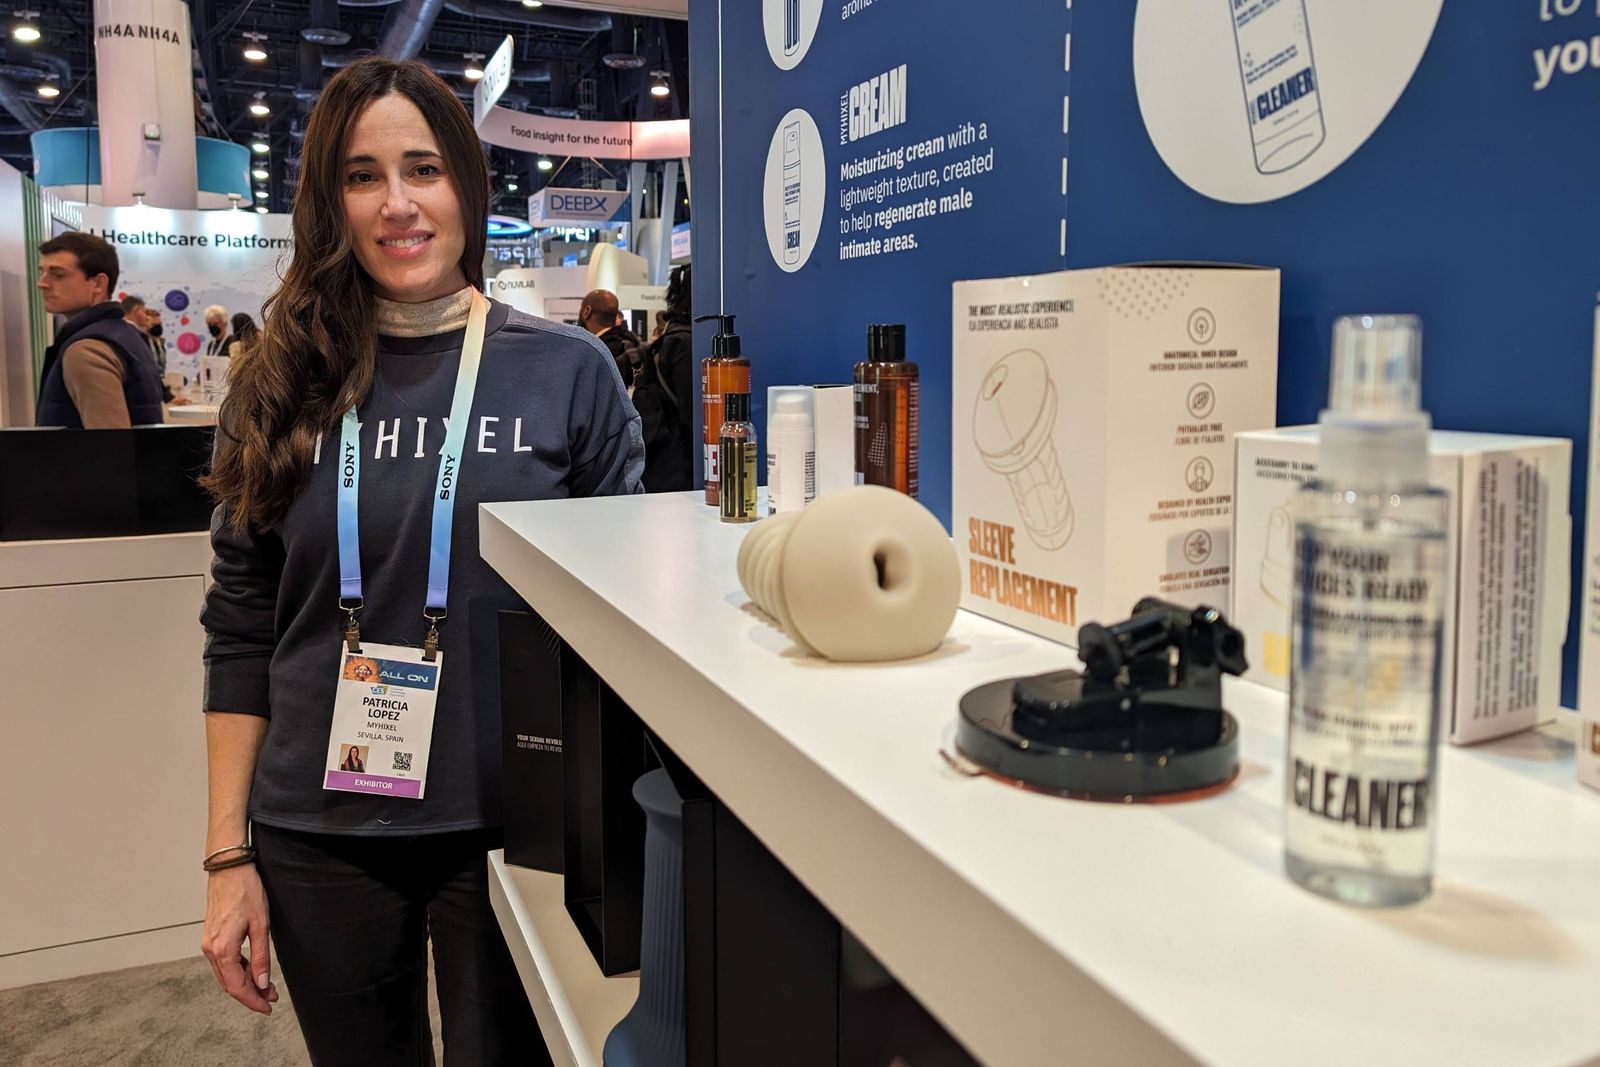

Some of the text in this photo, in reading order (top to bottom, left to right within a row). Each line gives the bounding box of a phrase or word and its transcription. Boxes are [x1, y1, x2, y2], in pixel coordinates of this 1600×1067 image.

[98, 24, 180, 46] NH4A NH4A
[849, 63, 907, 142] CREAM
[1256, 66, 1316, 121] CLEANER
[511, 125, 633, 146] Food insight for the future
[840, 90, 848, 145] MYHIXEL
[840, 121, 988, 182] Moisturizing cream with a
[840, 177, 894, 211] lightweight
[896, 169, 940, 194] texture,
[943, 147, 994, 182] created
[550, 194, 607, 212] DEEPX
[840, 187, 973, 234] to help regenerate male
[102, 229, 208, 247] Healthcare
[215, 234, 291, 249] Platform
[840, 233, 918, 260] intimate areas.
[313, 416, 532, 464] HIEL
[343, 441, 356, 488] SONY
[439, 454, 456, 500] SONY
[968, 515, 1016, 566] SLEEVE
[969, 557, 1078, 628] REPLACEMENT
[379, 670, 429, 683] ALL ON
[362, 696, 409, 712] PATRICIA
[367, 721, 398, 732] MYHIXEL
[368, 708, 400, 721] LOPEZ
[357, 731, 404, 743] SEVILLA, SPAIN
[354, 778, 393, 790] EXHIBITOR
[1295, 757, 1428, 832] CLEANER
